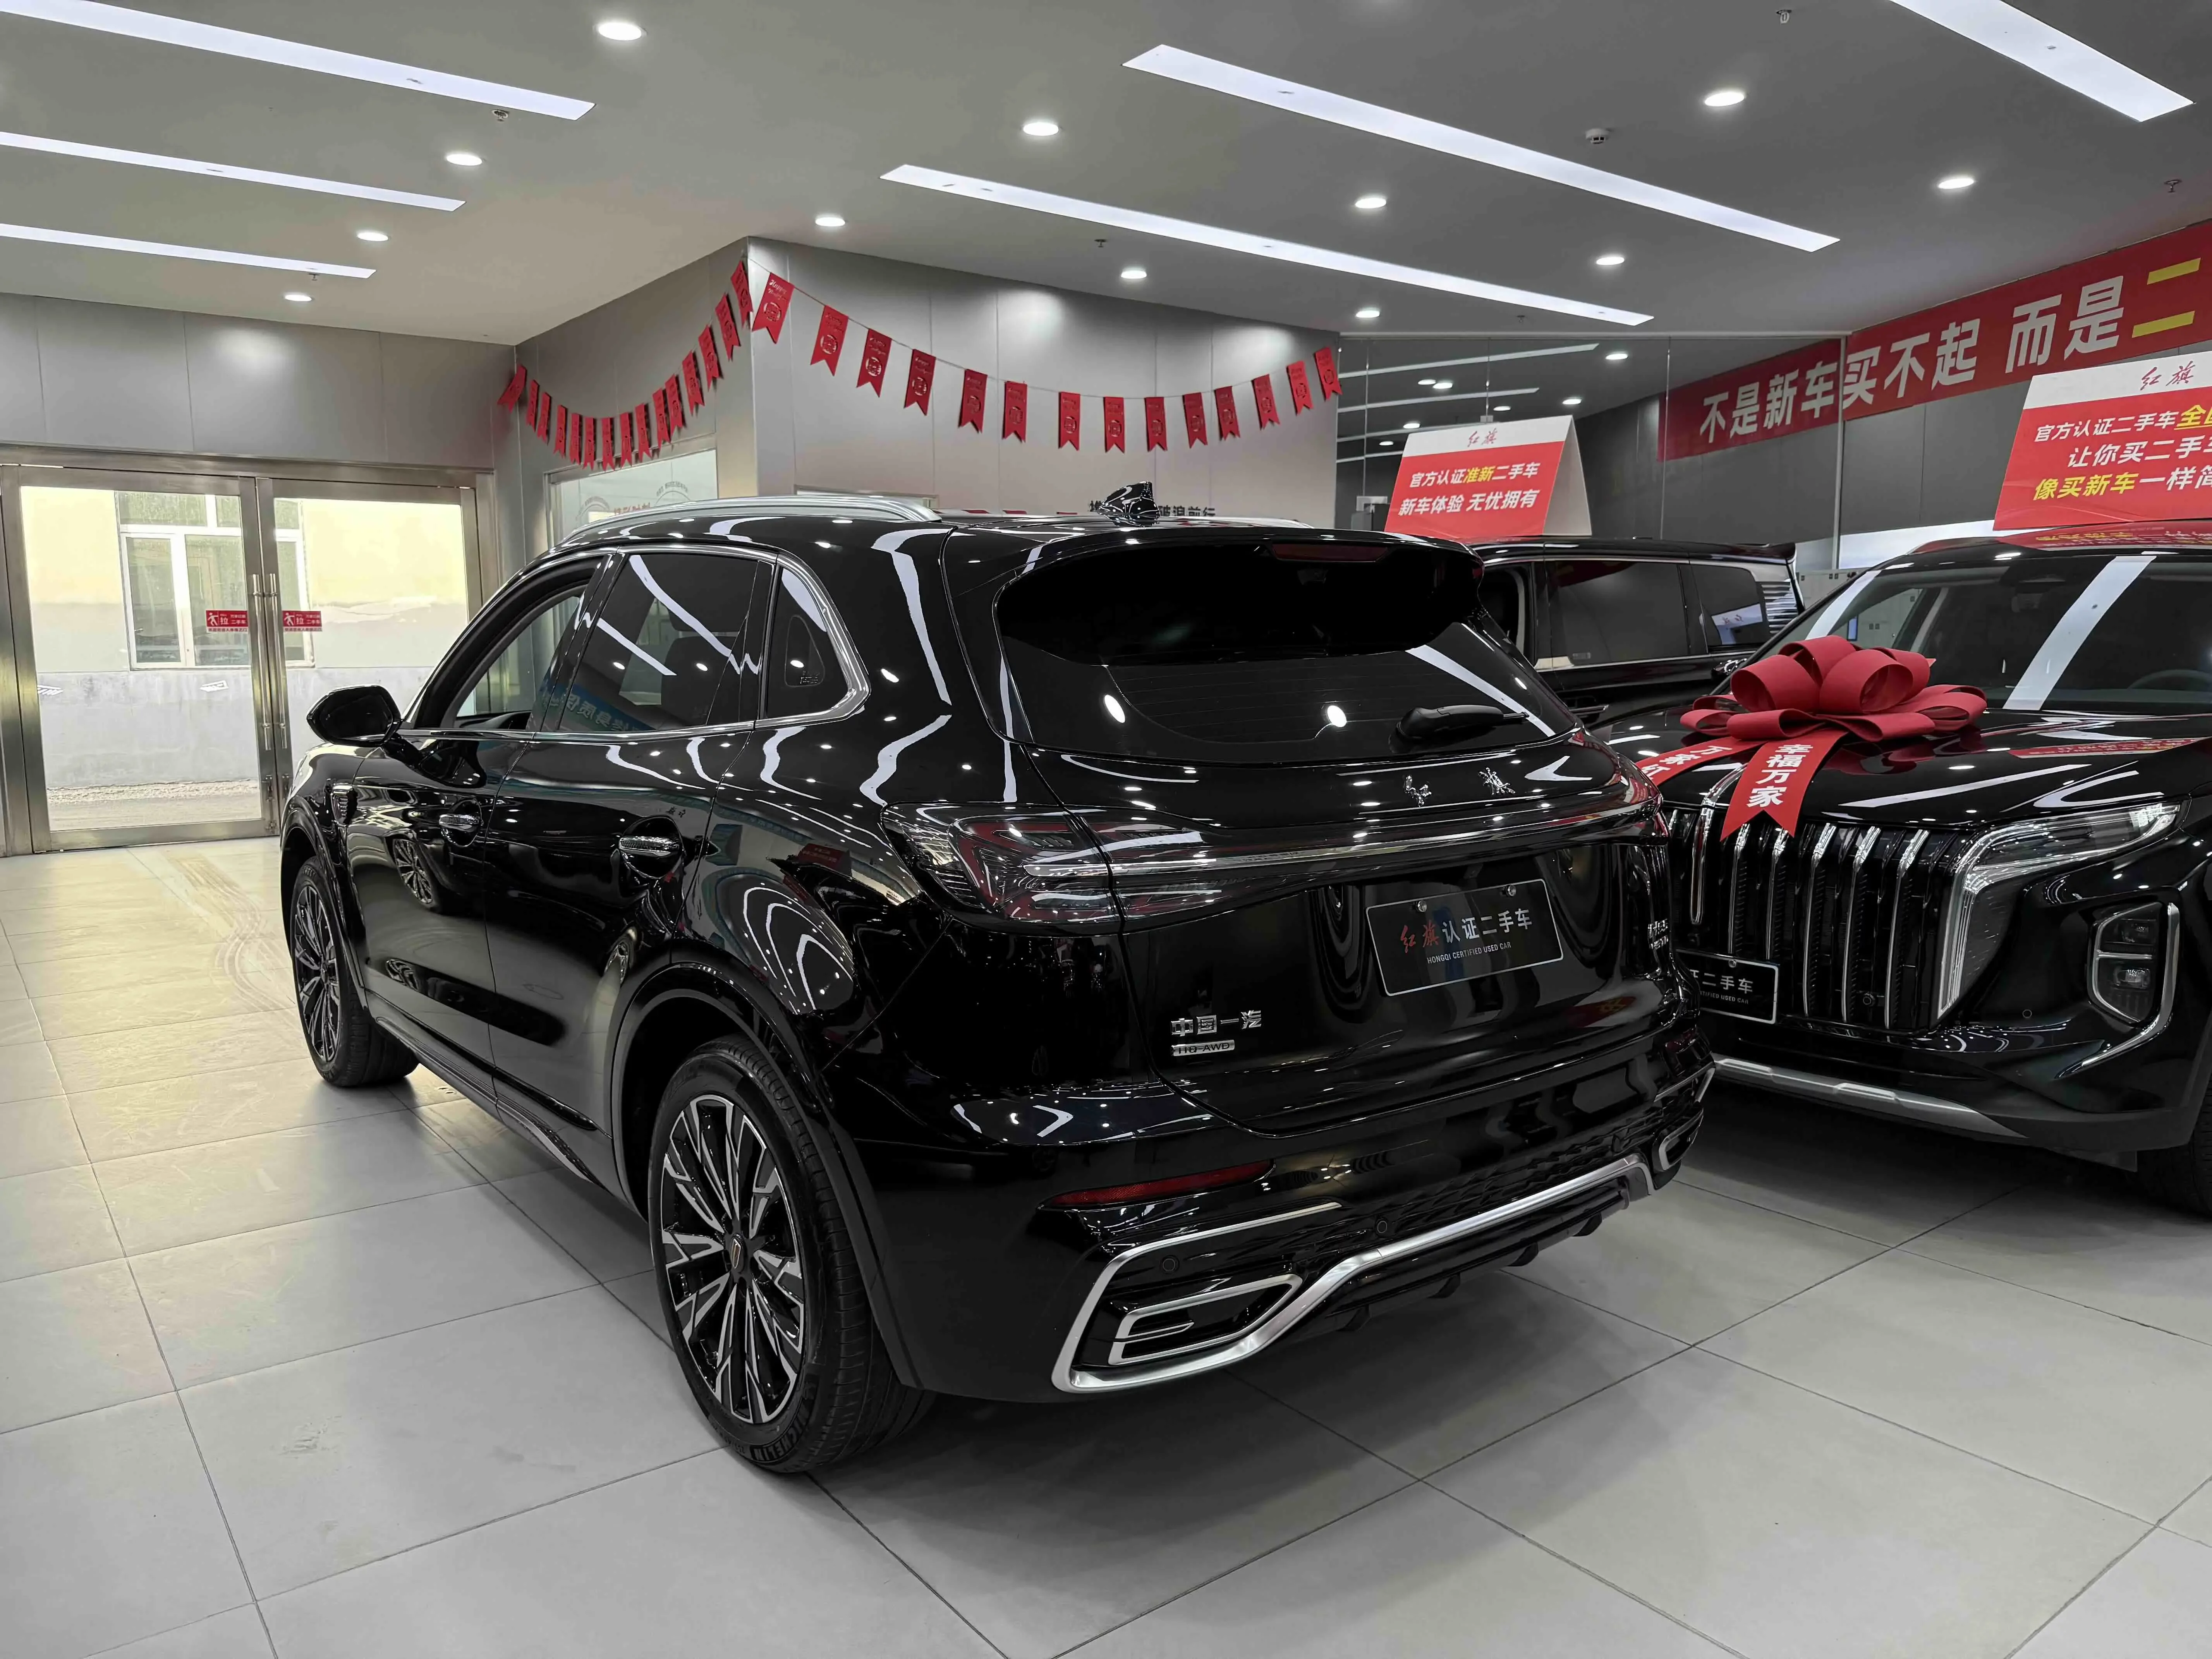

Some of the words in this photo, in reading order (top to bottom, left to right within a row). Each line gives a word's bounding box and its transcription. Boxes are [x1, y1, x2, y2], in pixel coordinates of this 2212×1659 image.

[1700, 319, 1980, 443] 不是新车买不起
[2006, 258, 2201, 373] 而是二
[2140, 361, 2195, 390] 红旗
[1467, 428, 1498, 447] 红旗
[1409, 462, 1541, 488] 官方认证准新二手车
[1398, 495, 1465, 516] 新车体验
[1466, 489, 1540, 512] 无忧拥有
[1746, 744, 1814, 808] 幸福万家
[1400, 908, 1532, 954] 红旗认证二手车
[1427, 953, 1451, 964] HONGQI
[1453, 947, 1482, 959] CERTIFIED
[1483, 944, 1499, 953] USED
[1499, 941, 1512, 950] CAR
[1171, 1010, 1262, 1037] 中国一汽
[1178, 1043, 1230, 1054] HQ-AWD
